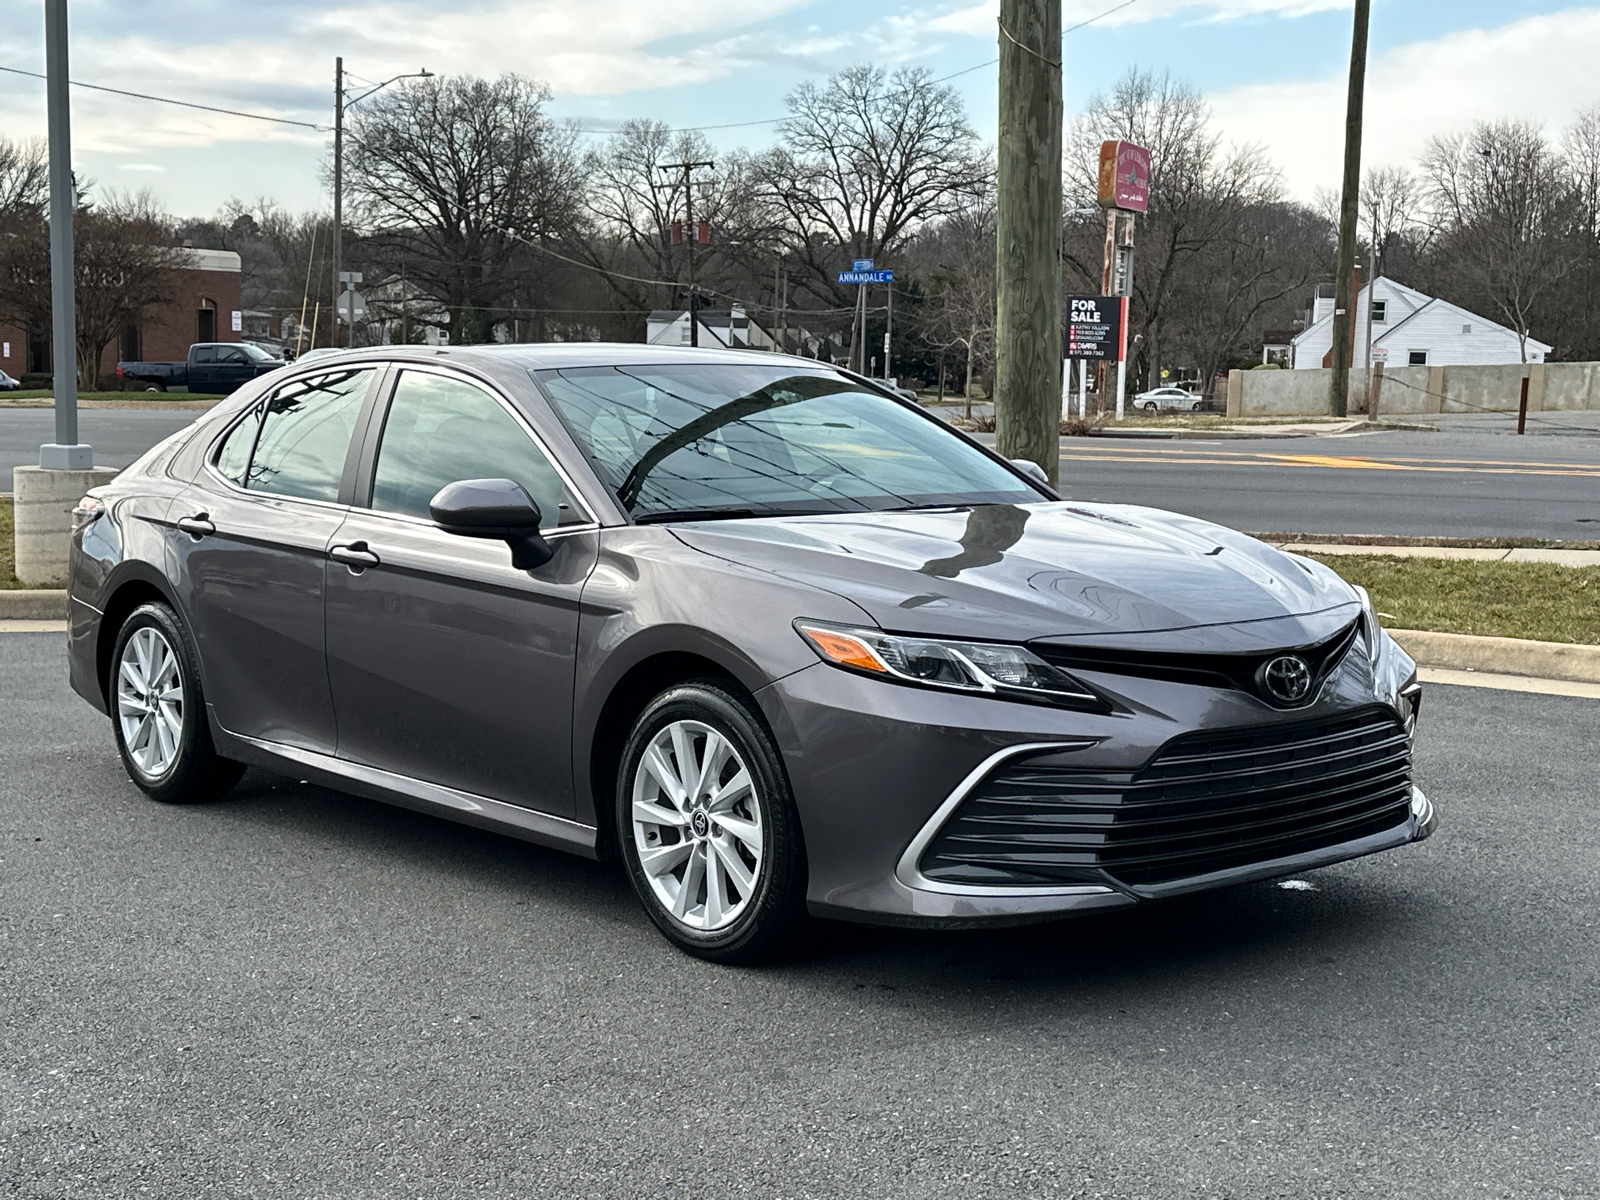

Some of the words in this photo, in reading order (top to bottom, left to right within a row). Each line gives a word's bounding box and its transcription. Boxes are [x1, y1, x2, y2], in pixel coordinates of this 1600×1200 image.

[839, 273, 884, 282] ANNANDALE
[1071, 300, 1096, 310] FOR
[1070, 312, 1101, 322] SALE
